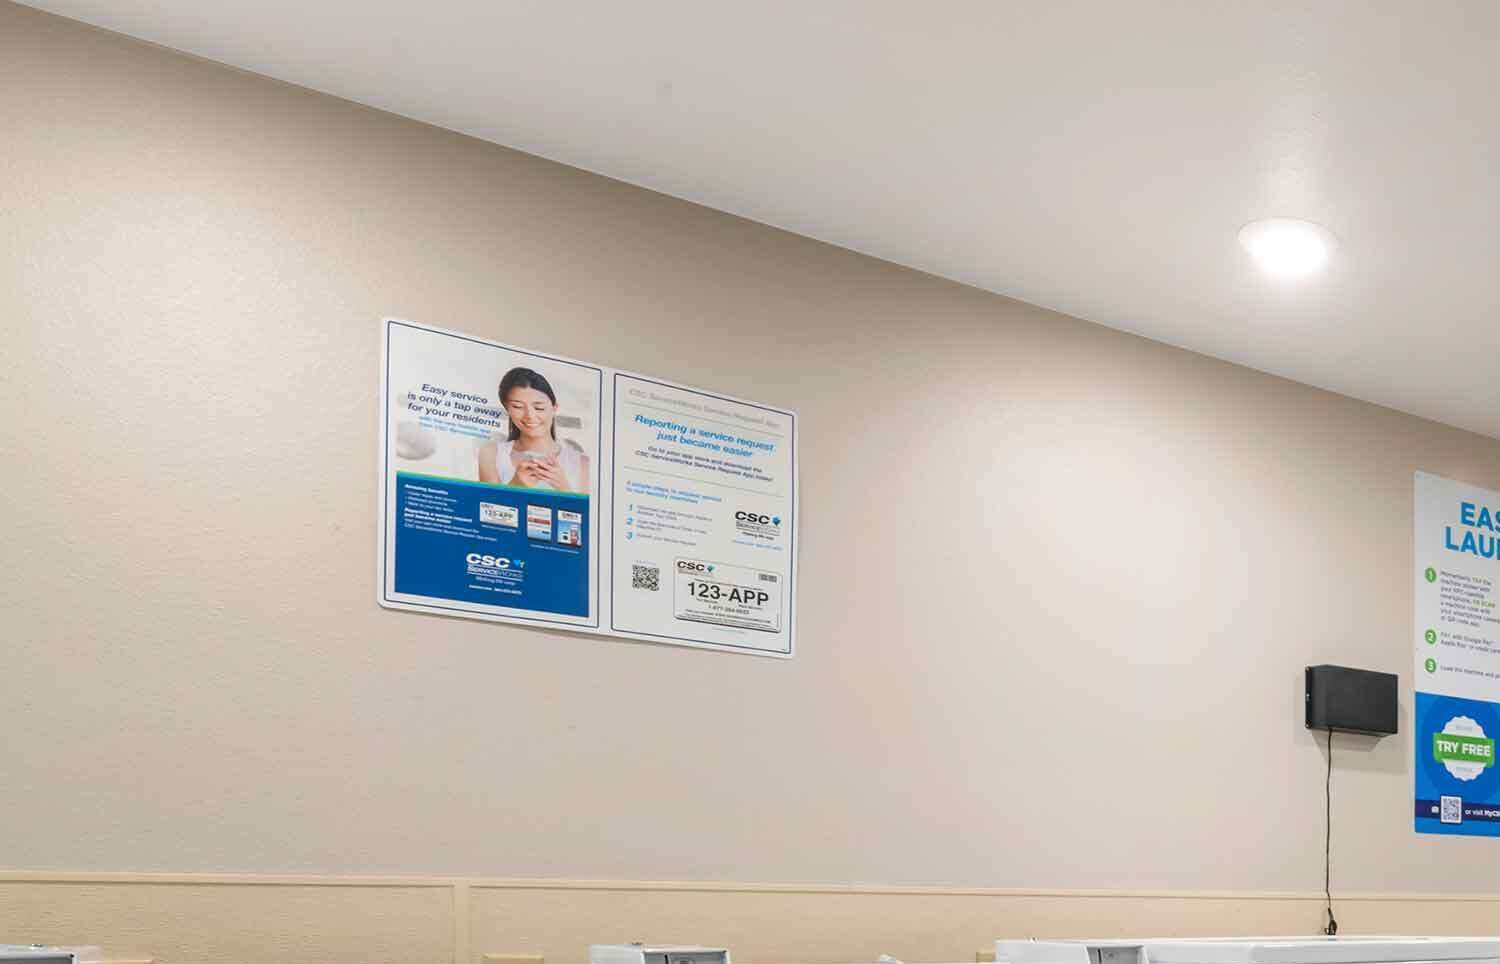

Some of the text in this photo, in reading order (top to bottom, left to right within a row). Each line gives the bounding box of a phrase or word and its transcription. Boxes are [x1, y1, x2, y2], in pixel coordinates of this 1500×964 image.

[422, 384, 488, 405] Easy service
[408, 392, 417, 401] is
[419, 395, 442, 407] only
[454, 402, 472, 413] tap
[474, 406, 502, 420] away
[408, 402, 425, 412] for
[426, 407, 451, 416] your
[452, 412, 502, 428] residents
[634, 415, 687, 434] Reporting
[698, 430, 735, 444] service
[736, 436, 774, 454] request
[656, 431, 754, 459] just became easier
[736, 511, 771, 525] CSC
[466, 553, 511, 569] CSC
[678, 561, 706, 571] CSC
[688, 582, 768, 606] 123-APP
[1437, 740, 1492, 760] TRY FREE
